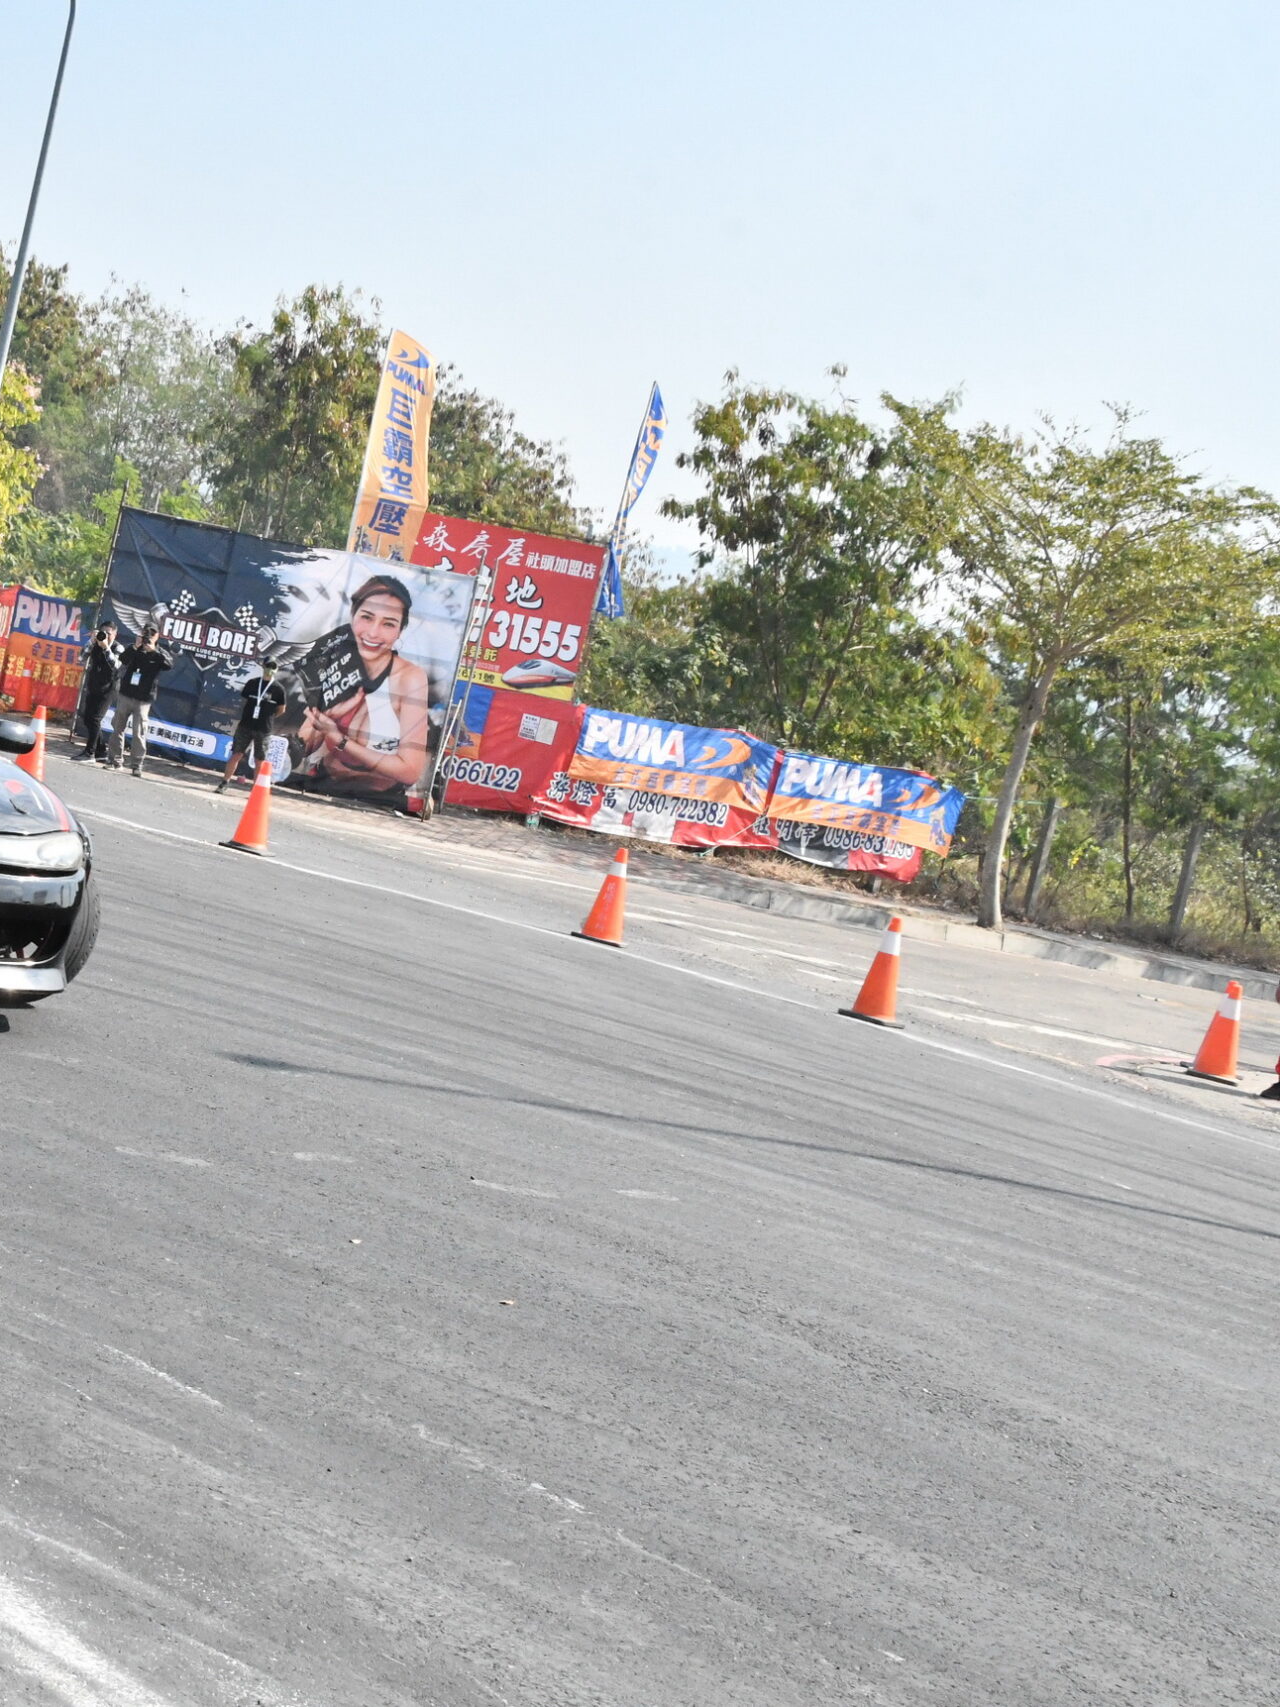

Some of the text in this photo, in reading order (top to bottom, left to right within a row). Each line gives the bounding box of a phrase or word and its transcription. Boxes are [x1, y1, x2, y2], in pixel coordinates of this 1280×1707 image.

[414, 520, 527, 566] 森房屋
[13, 593, 82, 642] PUMA
[162, 617, 257, 656] FULL BORE
[322, 671, 342, 692] AND
[582, 714, 686, 768] PUMA
[780, 757, 883, 808] PUMA
[627, 789, 729, 826] 0980-722382
